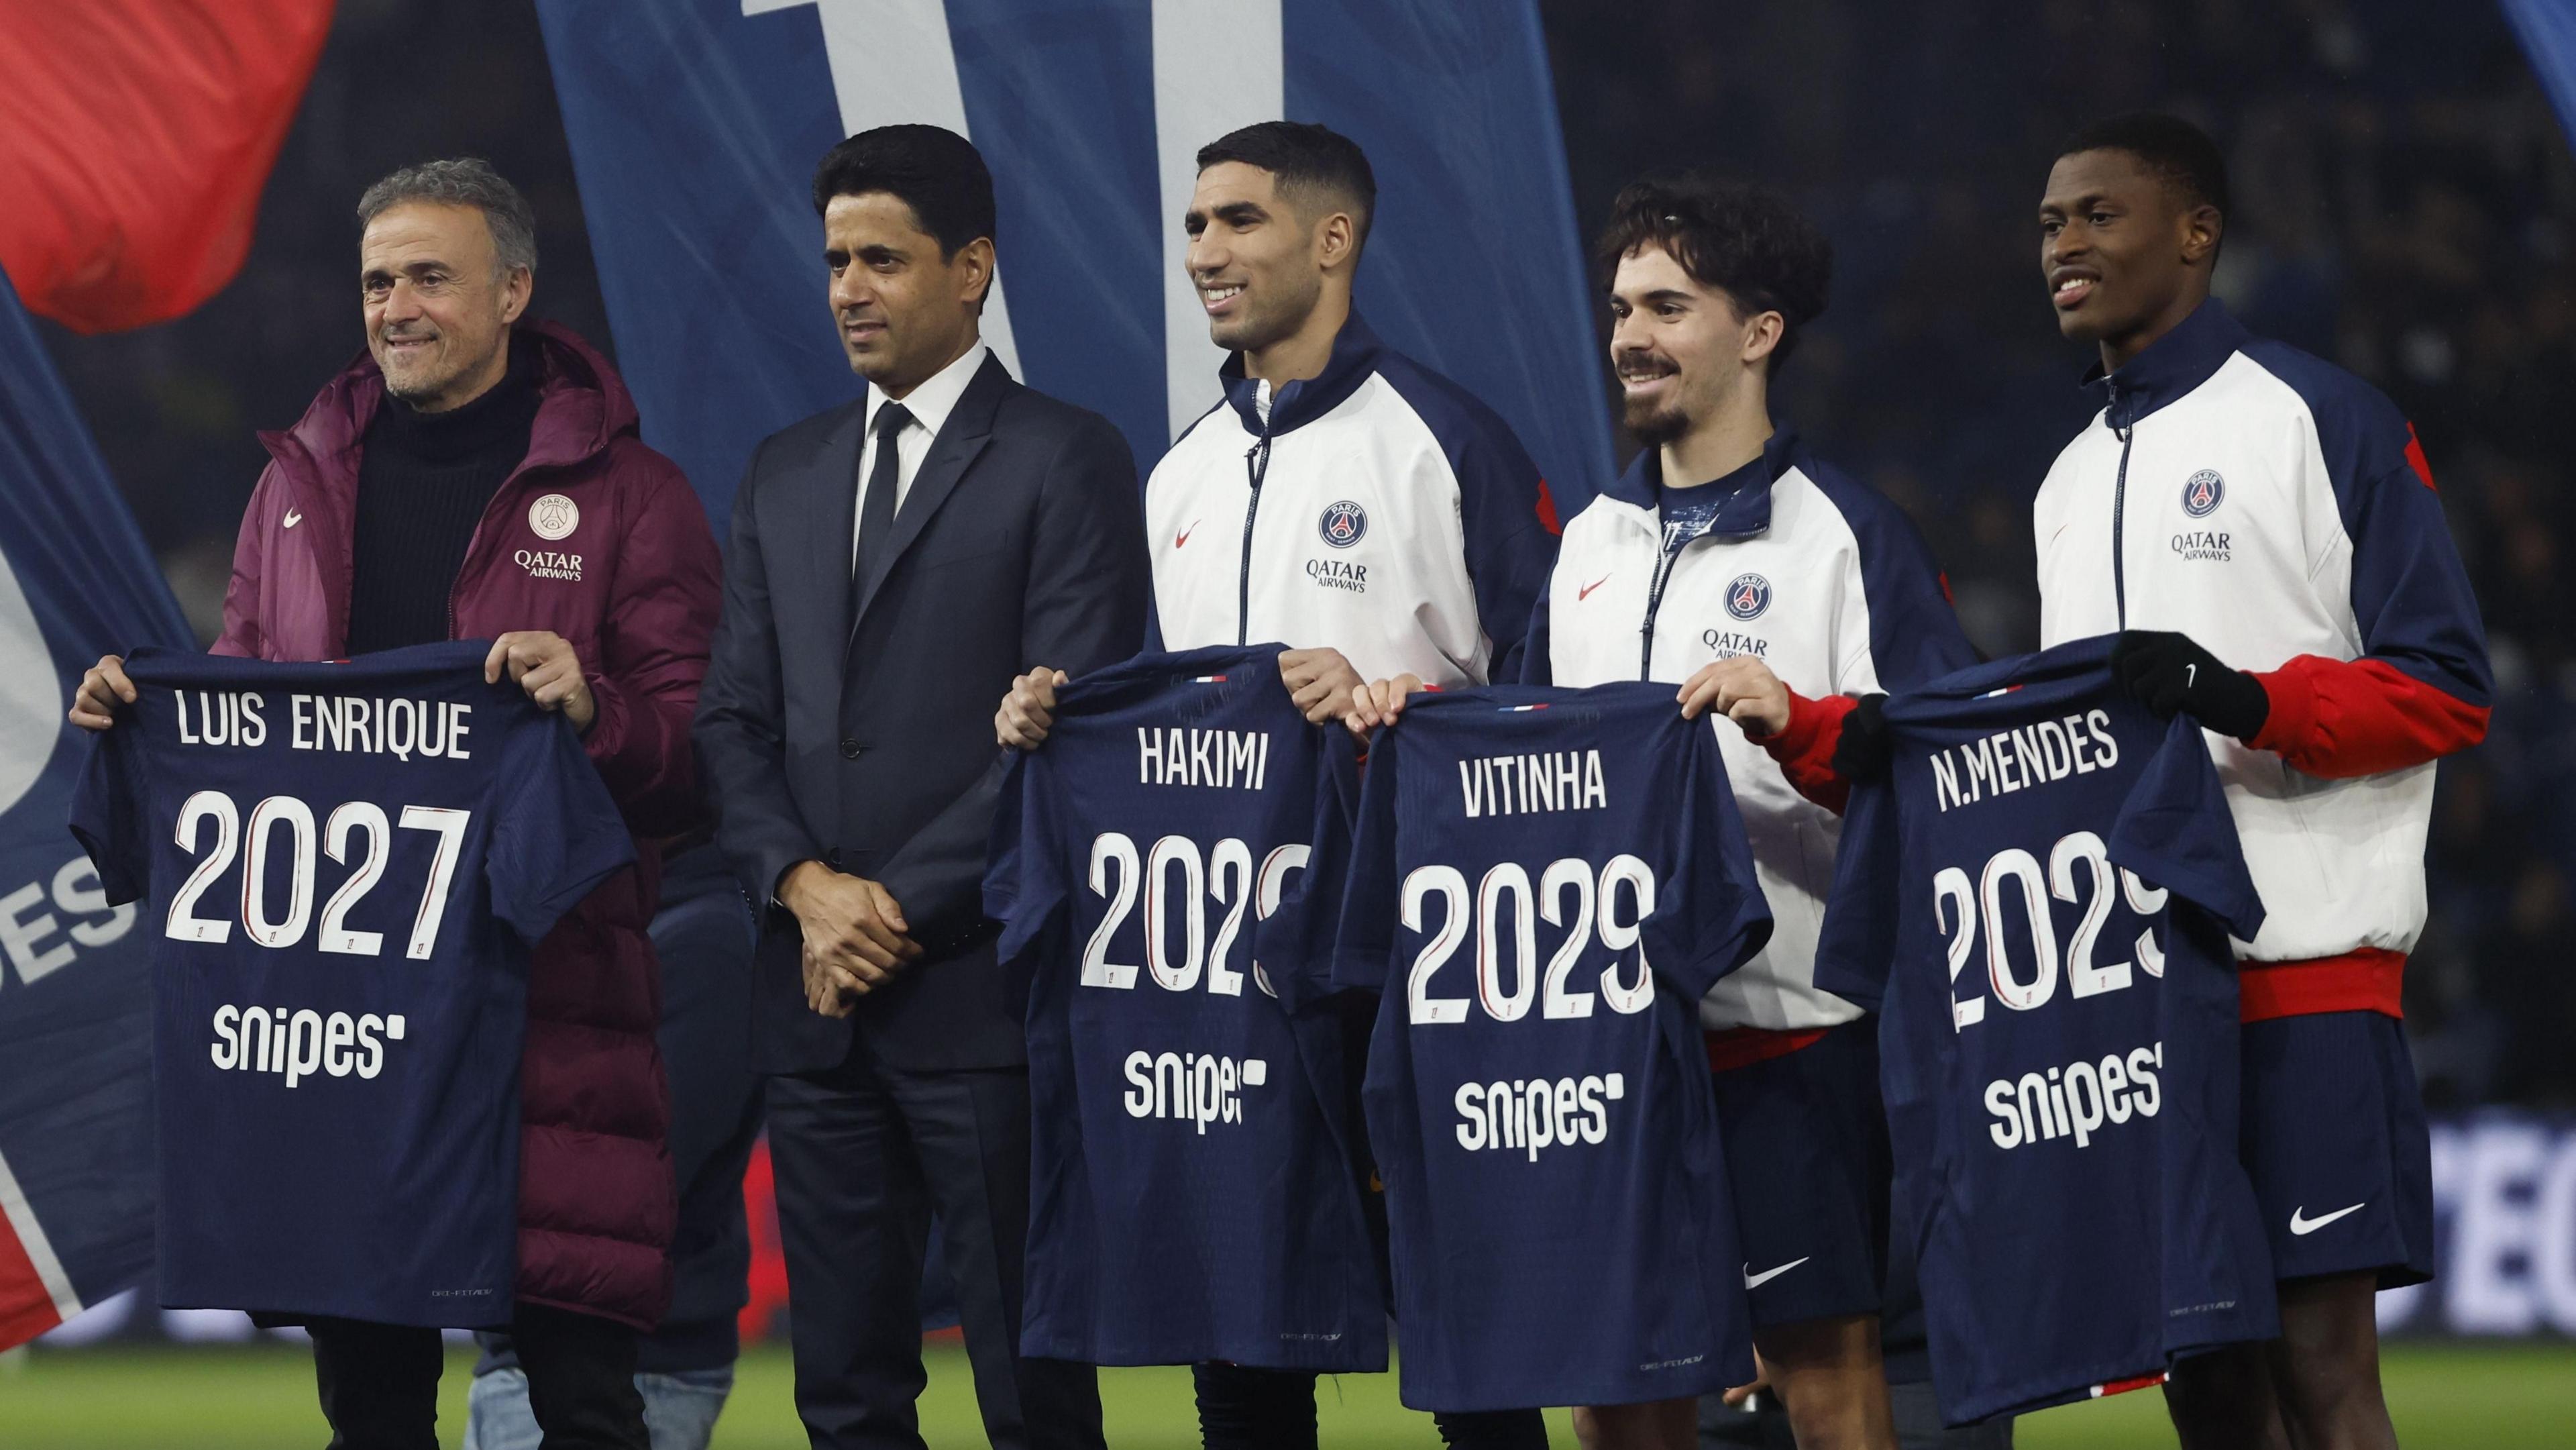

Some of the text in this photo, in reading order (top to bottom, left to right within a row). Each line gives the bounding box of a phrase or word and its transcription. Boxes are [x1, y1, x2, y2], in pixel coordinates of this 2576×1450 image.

[2191, 472, 2218, 485] PARIS
[540, 498, 570, 509] PARIS
[1331, 504, 1360, 517] PARIS
[2171, 531, 2231, 554] QATAR
[2184, 550, 2231, 562] AIRWAYS
[515, 550, 582, 571] QATAR
[1306, 559, 1366, 582] QATAR
[529, 567, 582, 582] AIRWAYS
[1318, 577, 1365, 593] AIRWAYS
[1737, 576, 1766, 590] PARIS
[1703, 629, 1768, 656] QATAR
[174, 689, 472, 762] LUIS ENRIQUE
[1138, 727, 1269, 790] HAKIMI
[1929, 709, 2119, 813] N.MENDES
[1458, 749, 1607, 818] VITINHA
[165, 790, 472, 960] 2027
[1400, 853, 1656, 1025] 2029
[211, 1004, 385, 1088] snipes
[1124, 1050, 1242, 1135] snipe
[1984, 1042, 2163, 1149] snipes
[1454, 1074, 1608, 1162] snipes
